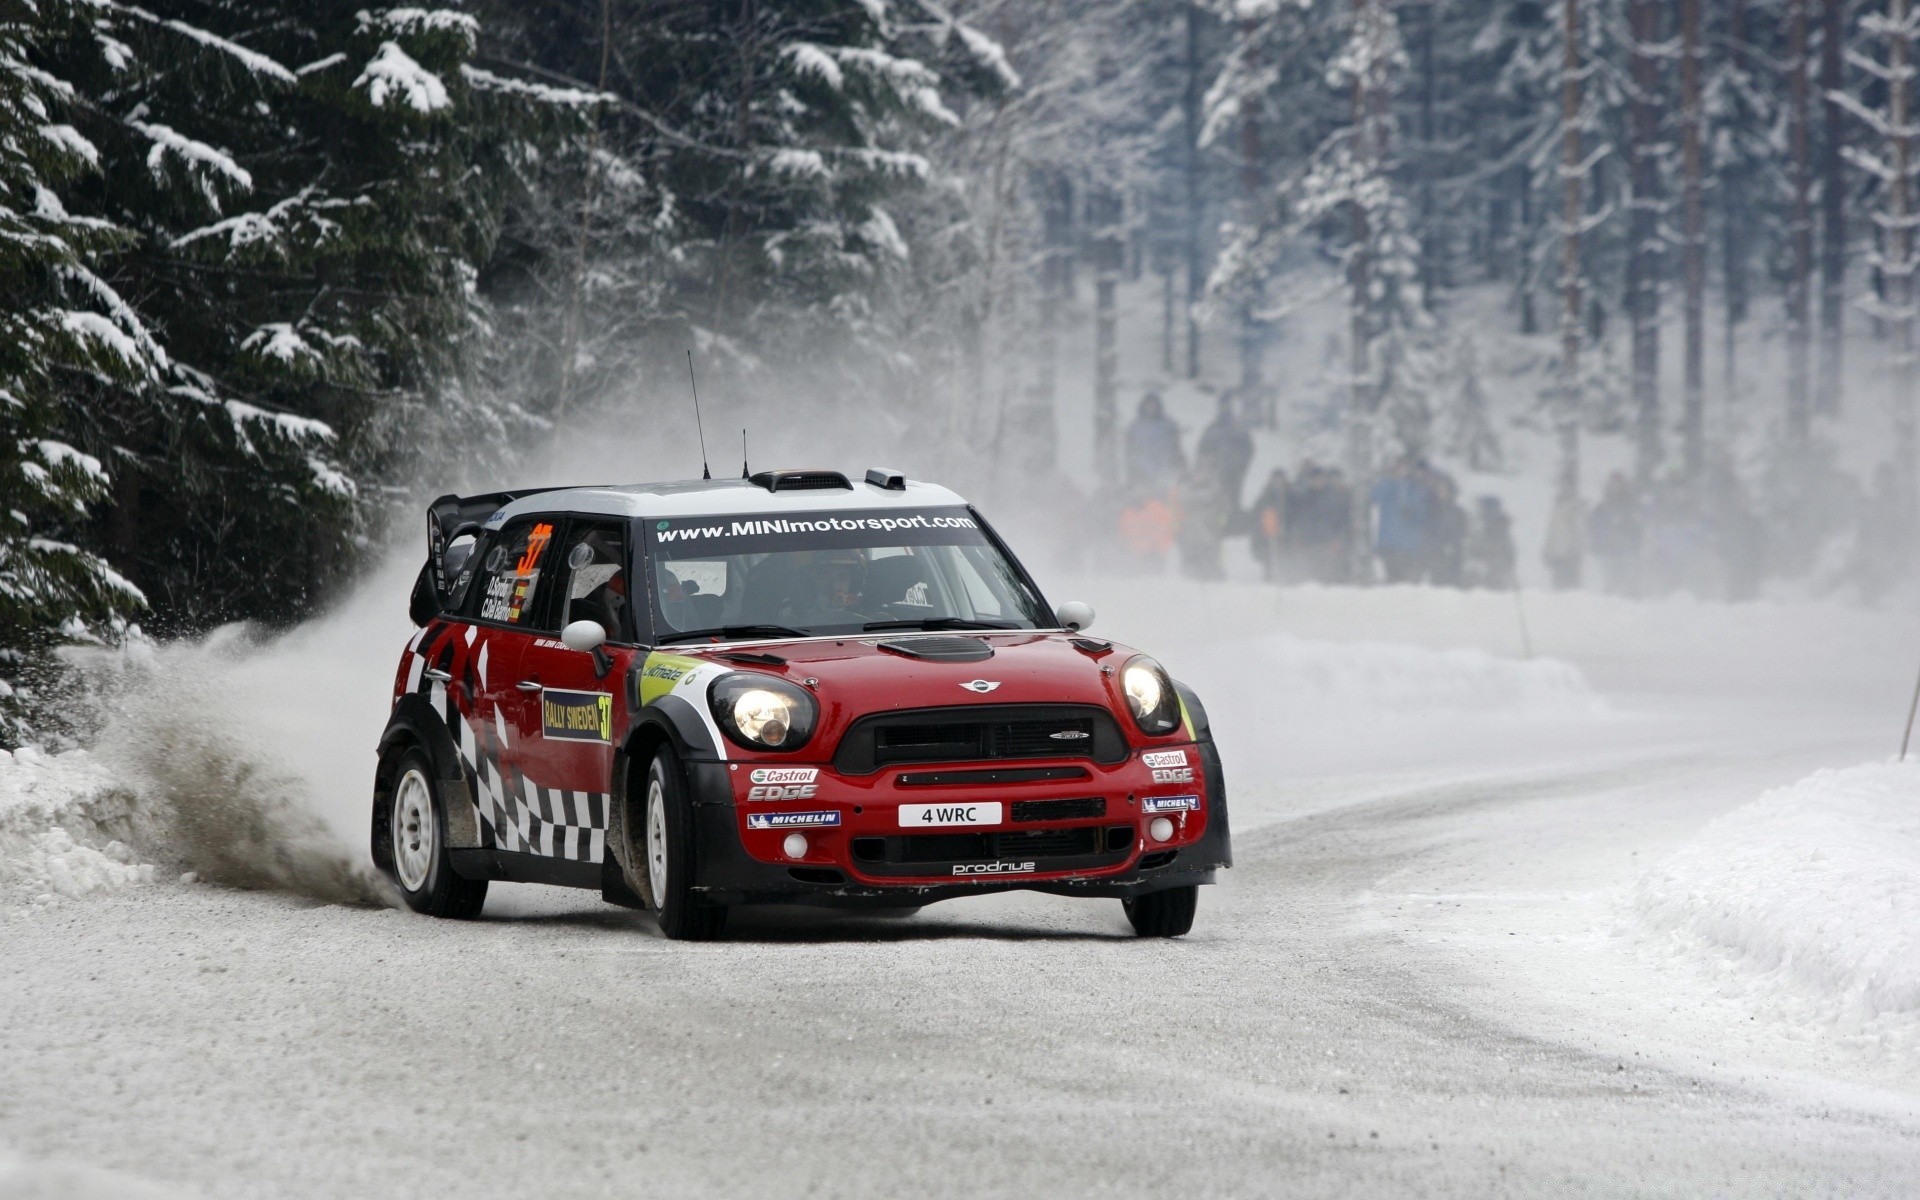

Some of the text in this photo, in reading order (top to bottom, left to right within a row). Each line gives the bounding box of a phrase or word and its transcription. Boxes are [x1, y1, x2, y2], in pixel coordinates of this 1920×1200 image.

[657, 516, 977, 542] www.MINImotorsport.com
[516, 522, 554, 577] 37
[545, 699, 600, 731] RALLY SWEDEN
[598, 695, 612, 741] 37
[1154, 753, 1185, 766] Castrol
[767, 771, 812, 782] Castrol
[1152, 768, 1194, 784] EDGE
[747, 785, 819, 801] EDGE
[771, 814, 836, 824] MICHELIN
[922, 807, 977, 823] 4 WRC
[952, 861, 1035, 876] prodrive
